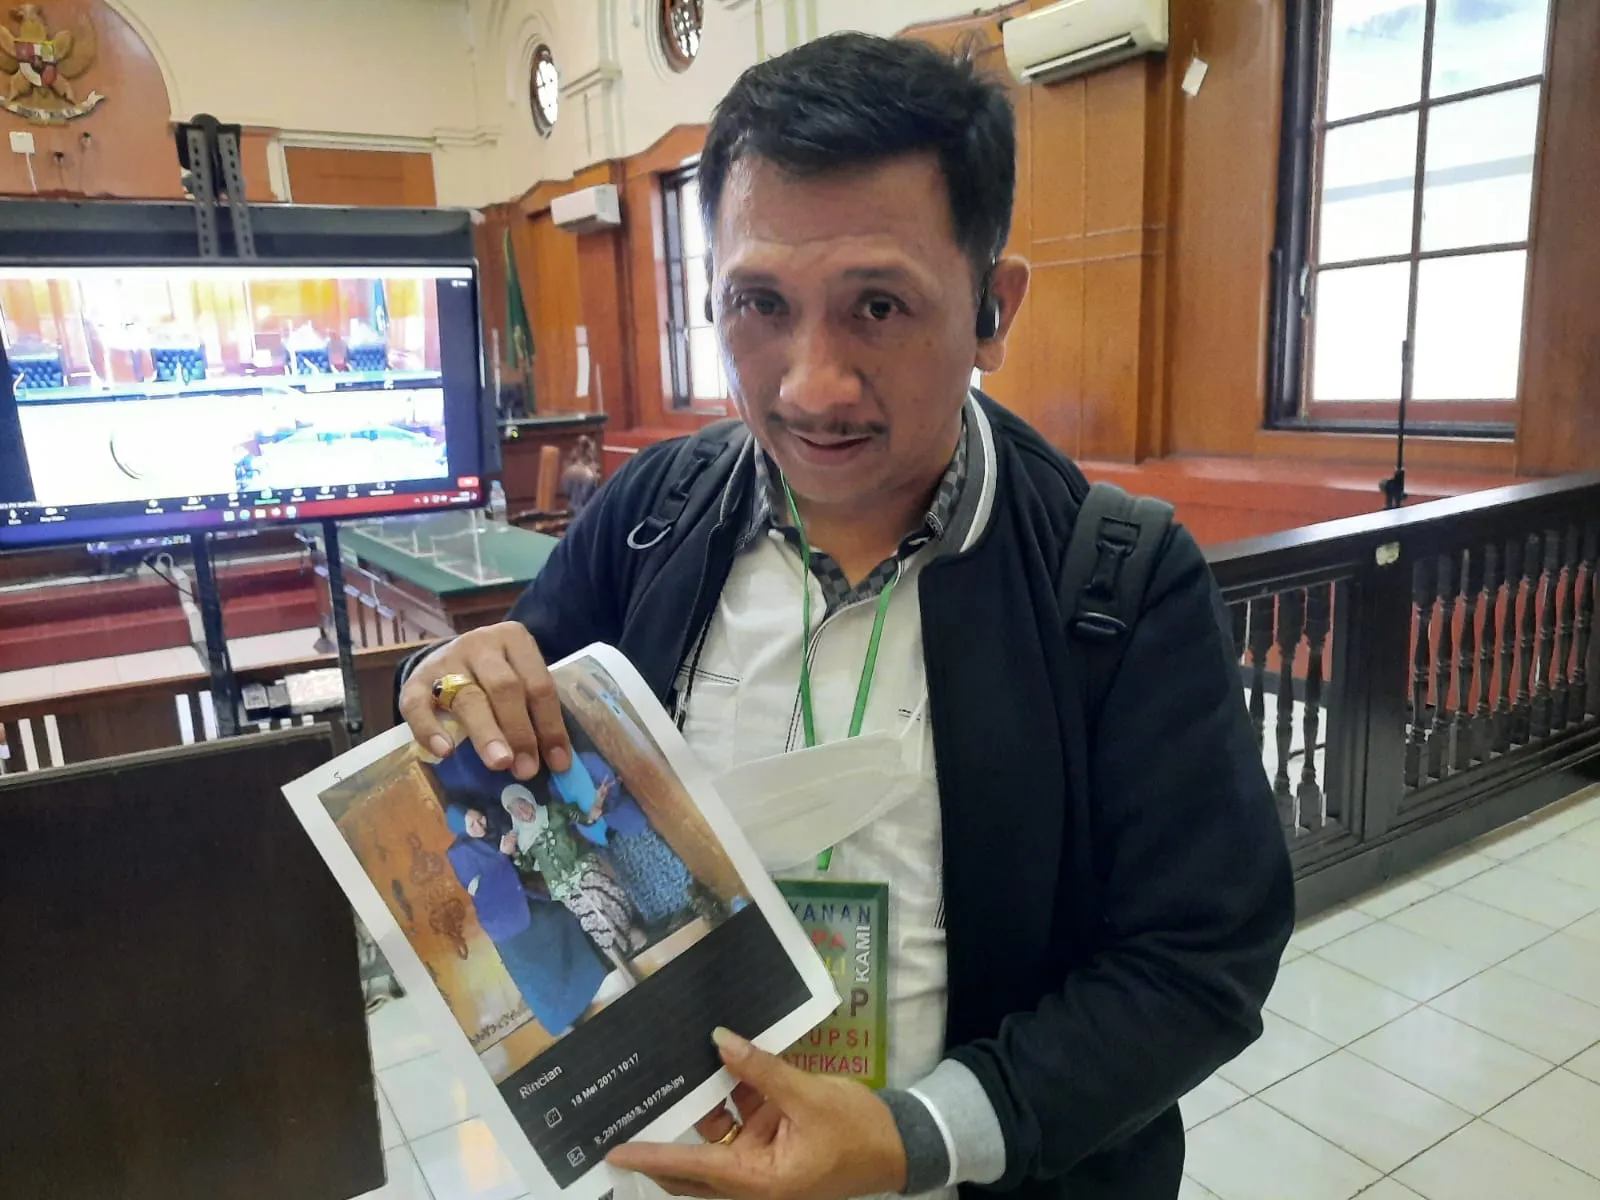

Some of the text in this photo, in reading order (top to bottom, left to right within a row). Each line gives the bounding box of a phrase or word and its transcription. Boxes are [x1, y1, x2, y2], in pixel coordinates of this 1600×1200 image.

[855, 925, 871, 982] KAMI
[519, 1066, 563, 1099] Rincian
[582, 1083, 598, 1100] Mei
[598, 1068, 617, 1089] 2017
[618, 1052, 639, 1072] 10:17
